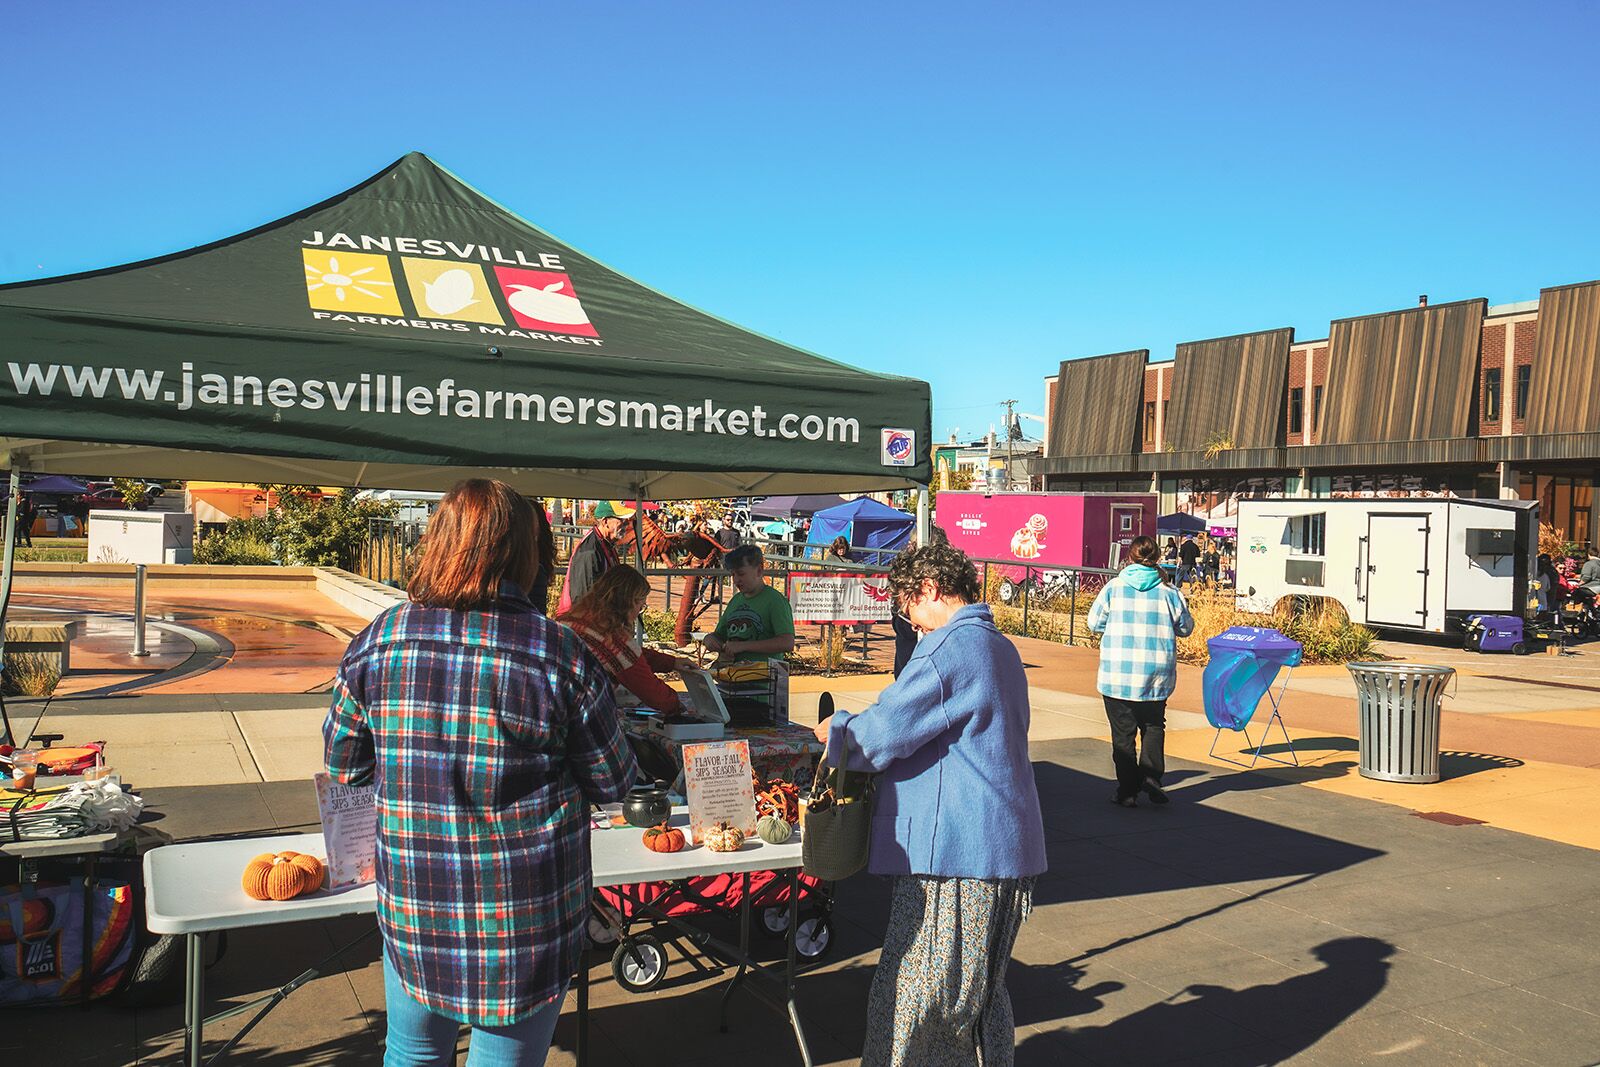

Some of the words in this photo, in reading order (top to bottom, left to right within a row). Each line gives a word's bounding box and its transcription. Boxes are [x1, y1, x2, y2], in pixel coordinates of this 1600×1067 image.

[302, 230, 566, 271] JANESVILLE
[312, 311, 471, 333] FARMERS
[478, 325, 604, 347] MARKET
[7, 361, 861, 444] www.janesvillefarmersmarket.com
[811, 582, 846, 590] JANESVILLE
[695, 766, 710, 778] SIPS
[712, 764, 737, 776] SEASON
[738, 763, 744, 774] 2
[331, 798, 349, 811] SIPS
[352, 793, 375, 807] SEASO
